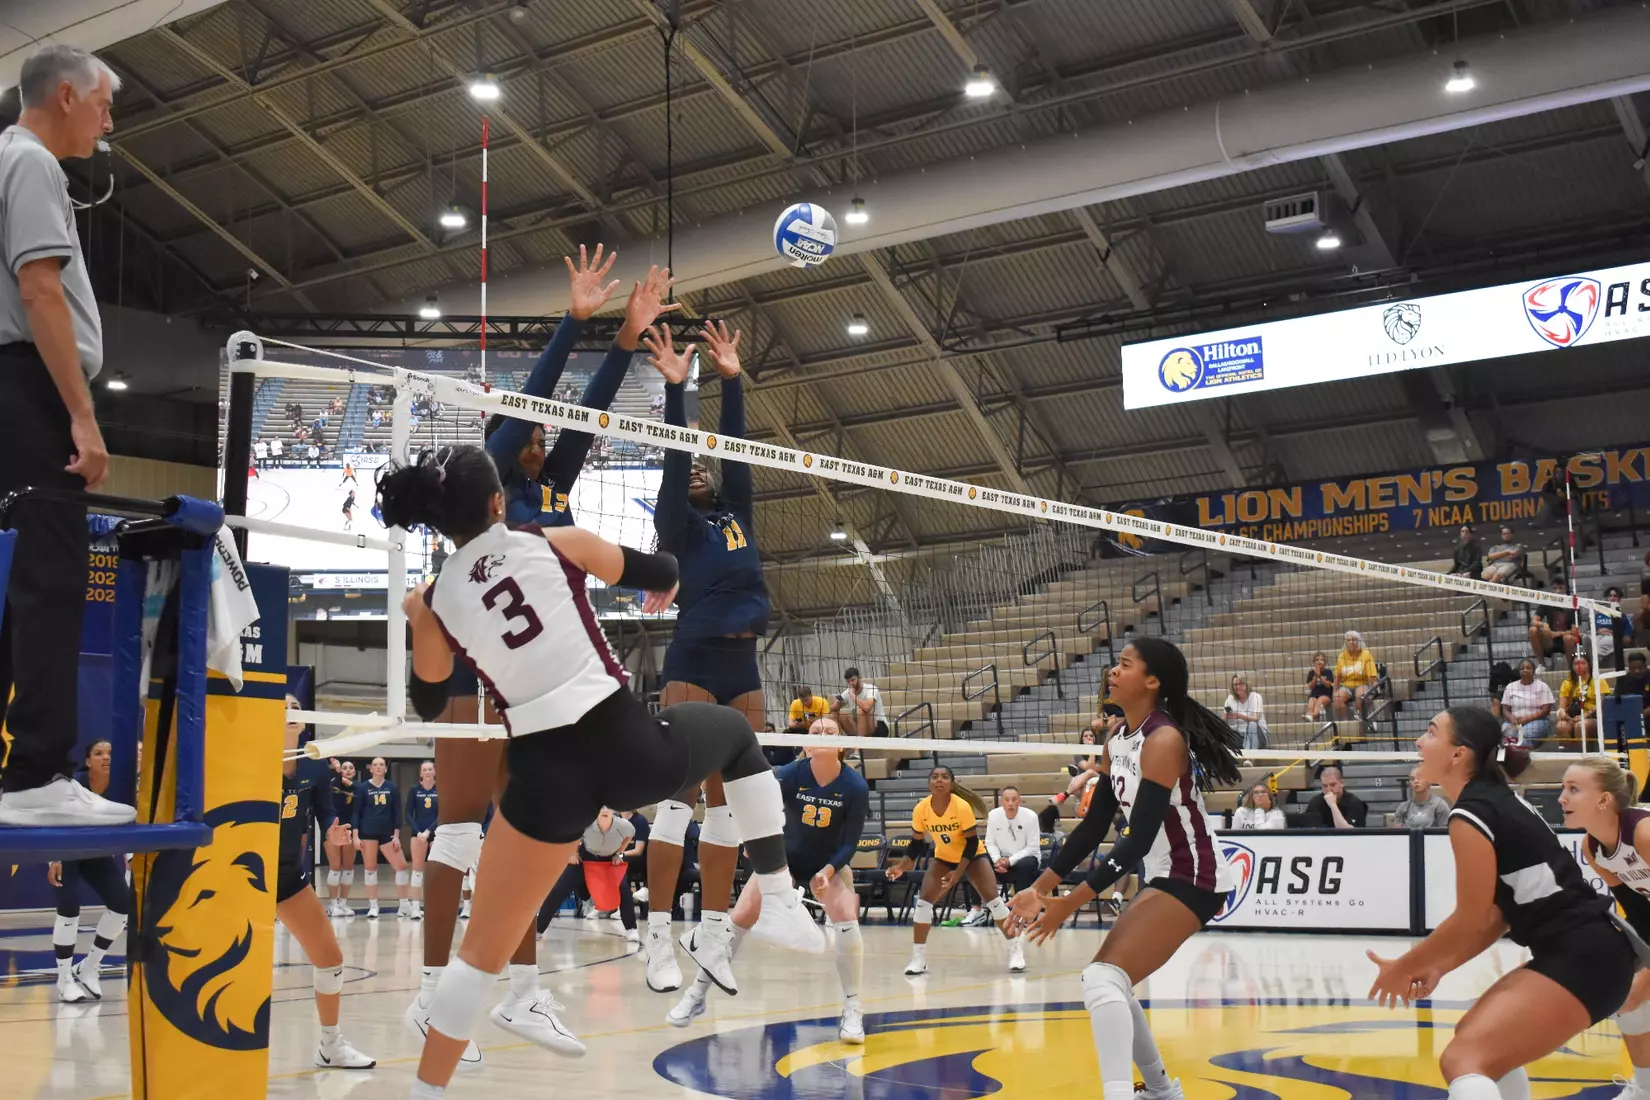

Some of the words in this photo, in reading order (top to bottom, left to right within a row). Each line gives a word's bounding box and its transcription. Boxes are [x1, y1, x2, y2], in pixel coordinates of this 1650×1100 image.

[789, 246, 822, 262] molten
[501, 394, 528, 409] EAST
[531, 401, 564, 418] TEXAS
[567, 408, 589, 422] A&M
[619, 419, 643, 434] EAST
[647, 425, 676, 440] TEXAS
[680, 432, 698, 444] A&M
[724, 441, 746, 454] EAST
[749, 446, 776, 460] TEXAS
[779, 451, 796, 463] A&M
[820, 459, 839, 470] EAST
[842, 464, 865, 476] TEXAS
[868, 469, 884, 480] A&M
[905, 475, 923, 487] EAST
[925, 480, 946, 492] TEXAS
[949, 485, 963, 495] A&M
[982, 492, 999, 502] EAST
[1001, 496, 1020, 506] TEXAS
[1022, 500, 1036, 509] A&M
[1196, 486, 1302, 526] LION
[1320, 467, 1478, 514] MEN'S
[1052, 505, 1067, 515] EAST
[1069, 509, 1087, 519] TEXAS
[1089, 512, 1101, 520] A&M
[1412, 508, 1422, 528] 7
[1428, 504, 1474, 527] NCAA
[1117, 516, 1130, 526] EAST
[1132, 519, 1148, 530] TEXAS
[1150, 524, 1161, 532] A&M
[1263, 512, 1389, 542] CHAMPIONSHIPS
[1175, 528, 1188, 537] EAST
[1189, 532, 1205, 541] TEXAS
[1229, 538, 1241, 546] EAST
[1242, 540, 1256, 549] TEXAS
[88, 570, 117, 586] 202
[86, 588, 115, 603] 202
[481, 576, 544, 650] 3
[374, 794, 386, 805] 14
[796, 793, 816, 802] EAST
[818, 798, 843, 807] TEXAS
[802, 804, 832, 828] 23
[926, 822, 960, 832] LIONS
[940, 834, 951, 844] 6
[1256, 856, 1344, 894] ASG
